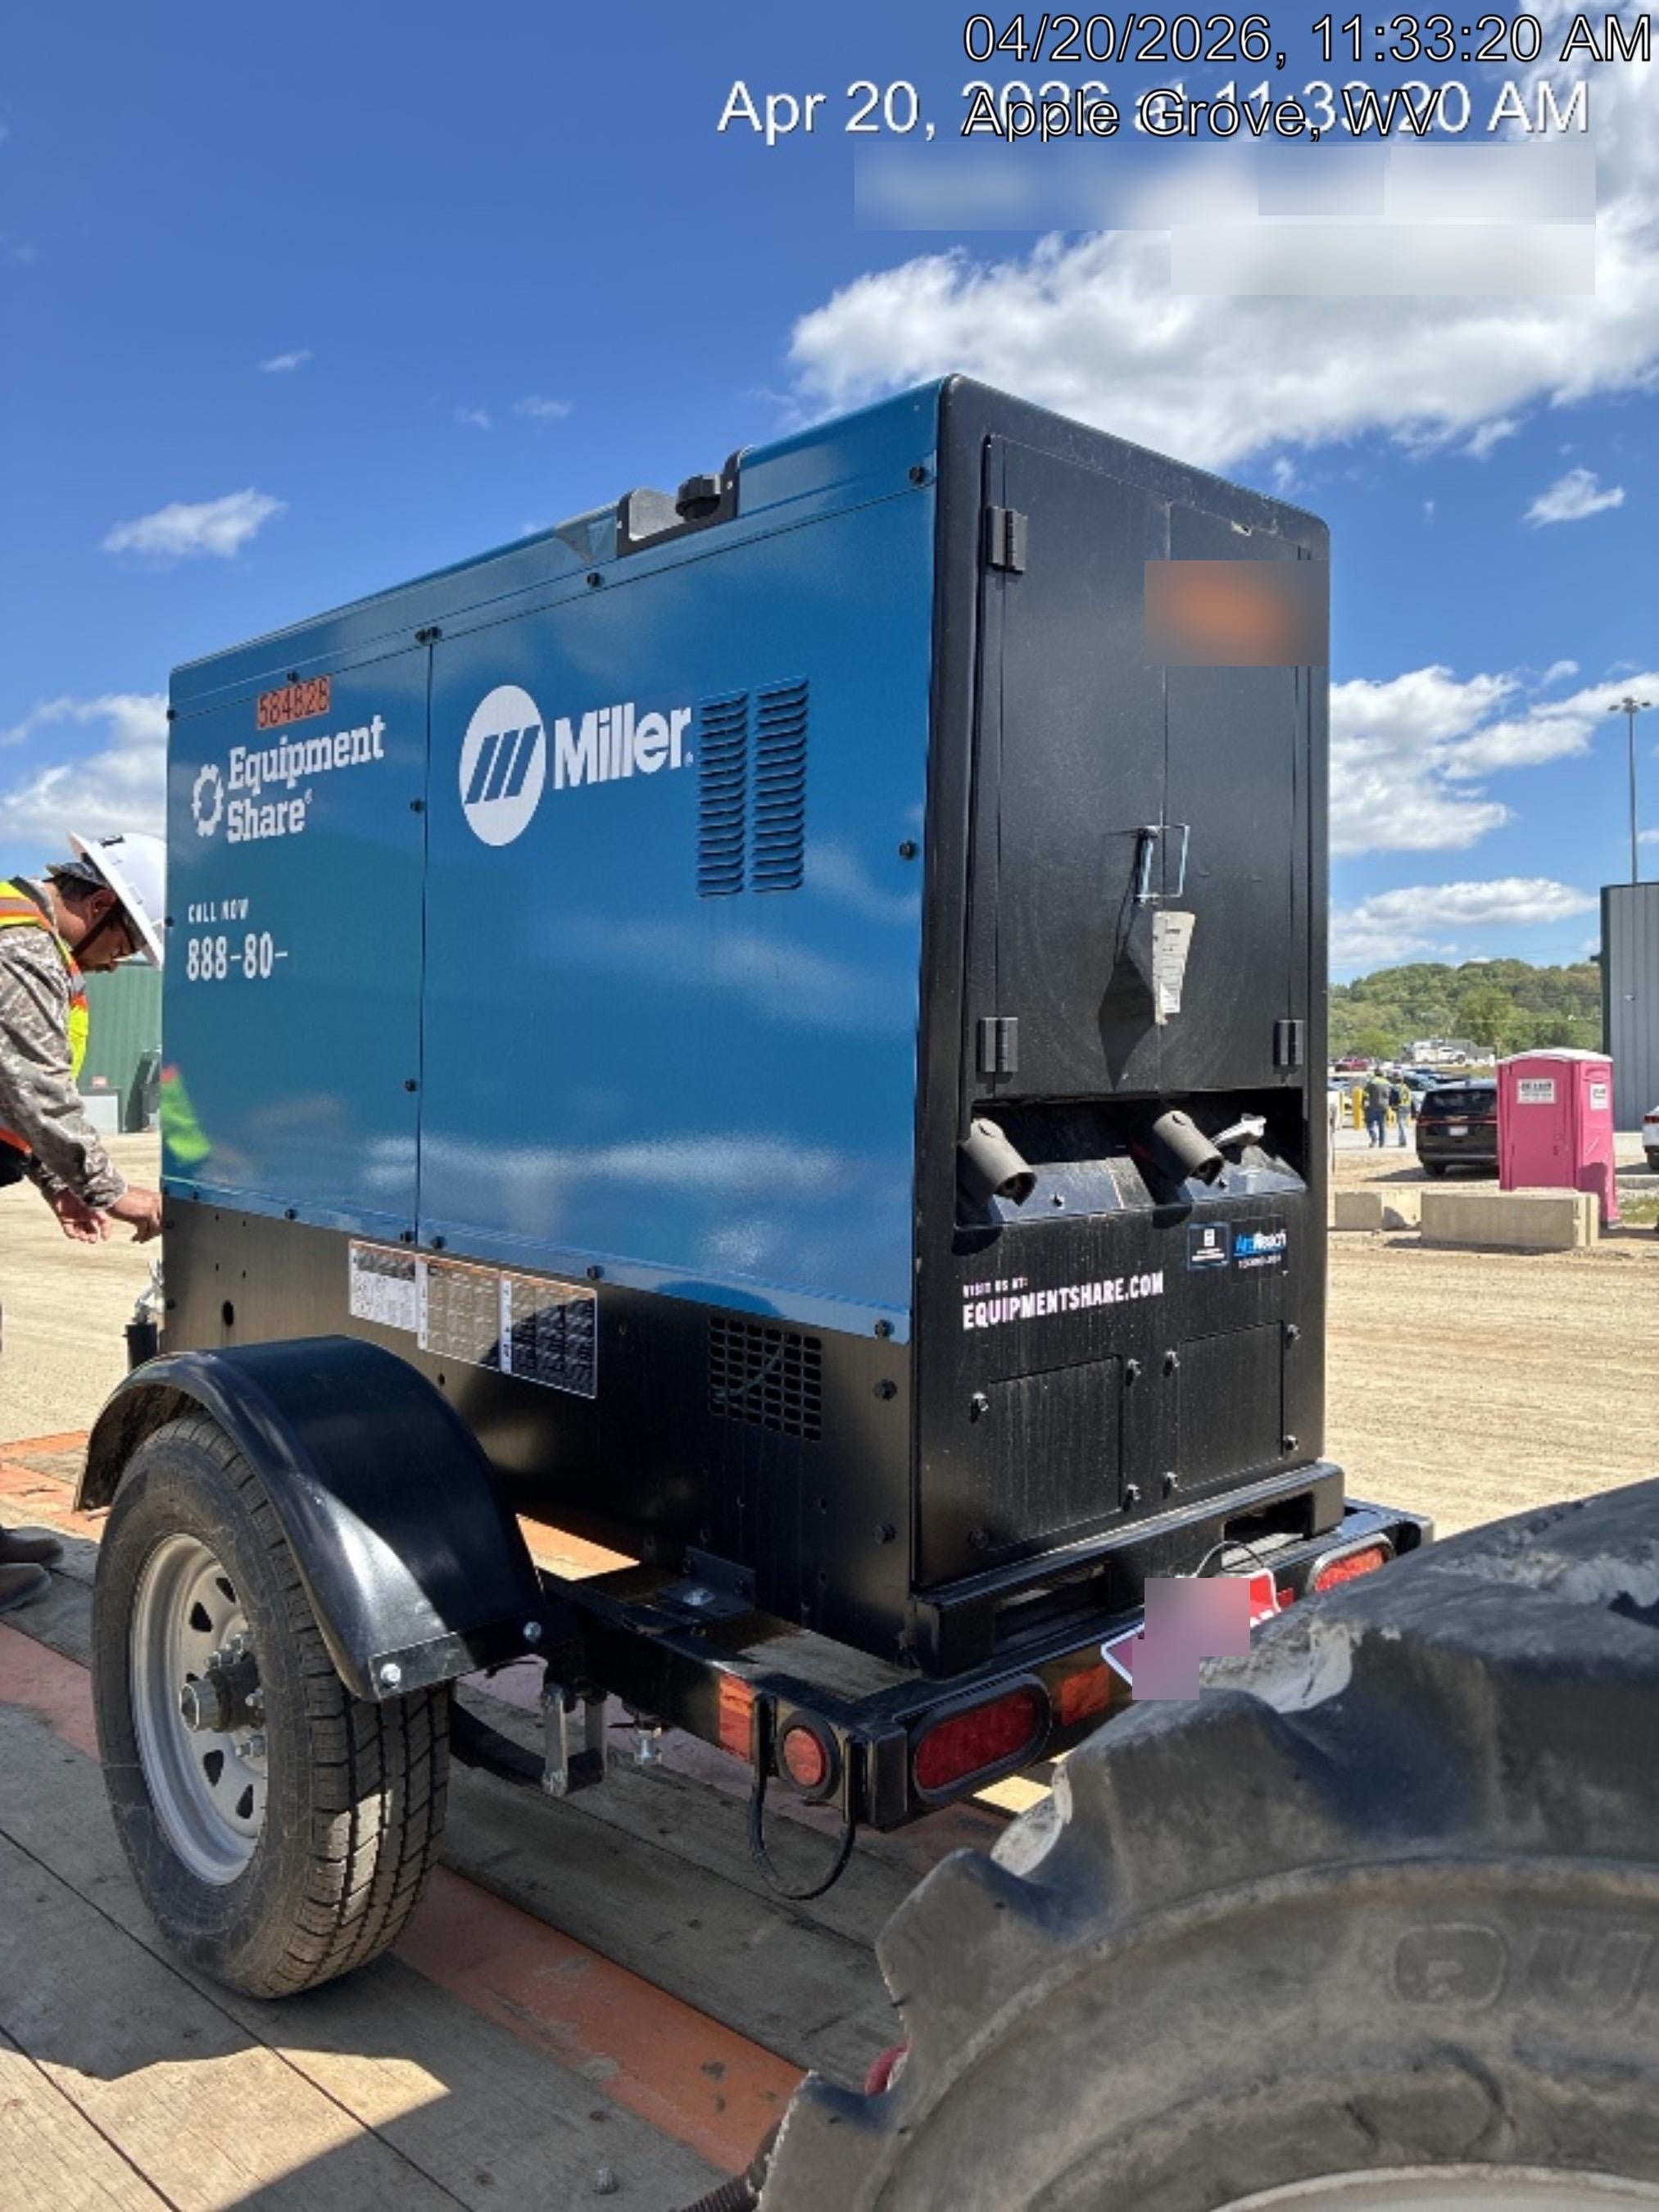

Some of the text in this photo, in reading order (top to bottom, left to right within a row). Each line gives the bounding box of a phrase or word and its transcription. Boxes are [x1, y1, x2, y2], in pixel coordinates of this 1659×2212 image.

[228, 714, 386, 794] Equipment
[554, 703, 691, 790] Miller
[188, 899, 248, 923] CALL NOW
[962, 1270, 1164, 1330] EQUIPMENTSHARE.COM
